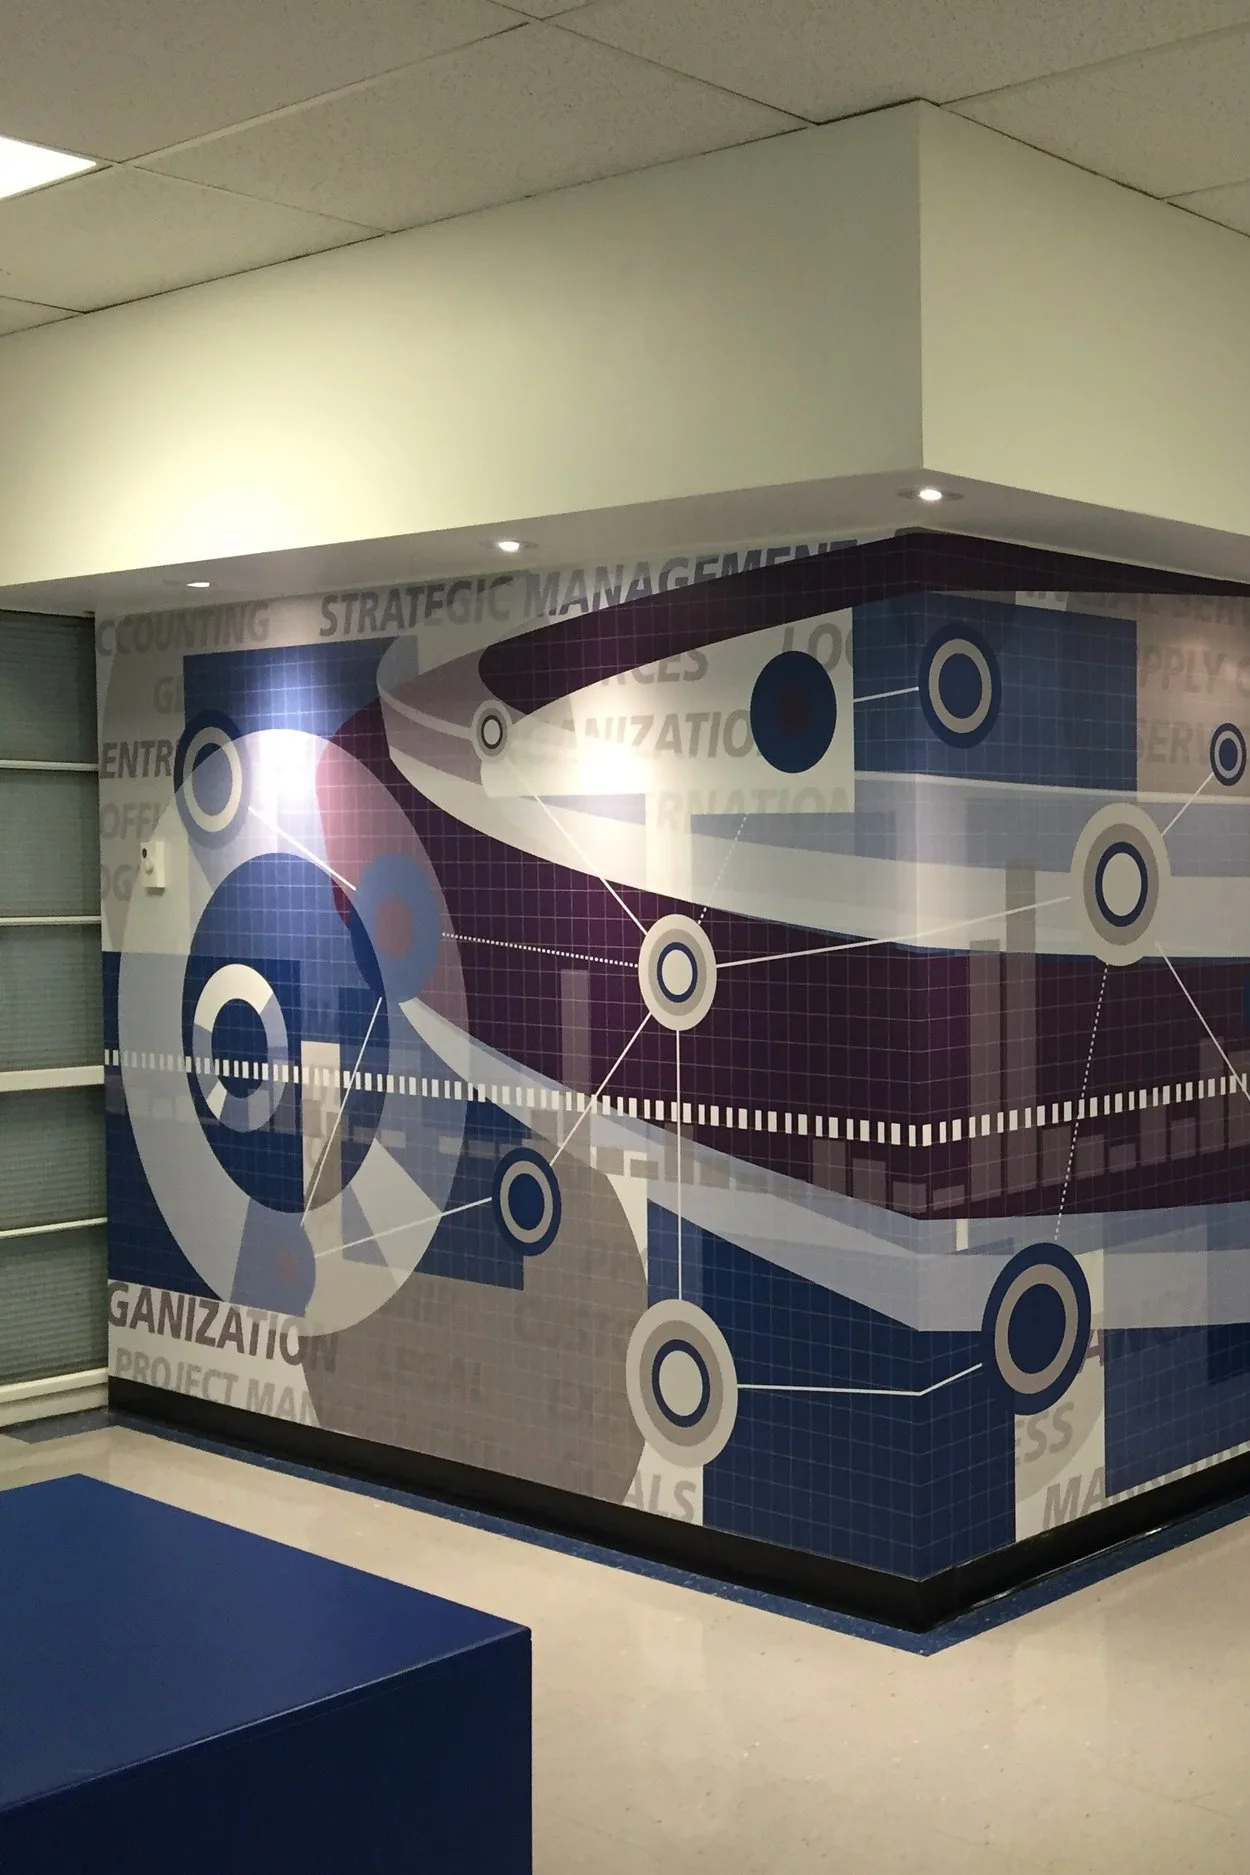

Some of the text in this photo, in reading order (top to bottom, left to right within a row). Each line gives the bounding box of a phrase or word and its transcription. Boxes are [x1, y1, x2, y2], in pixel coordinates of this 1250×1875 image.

[320, 541, 858, 637] STRATEGIC MANAGEM
[99, 739, 179, 780] ENTR
[115, 1346, 240, 1405] PROJECT
